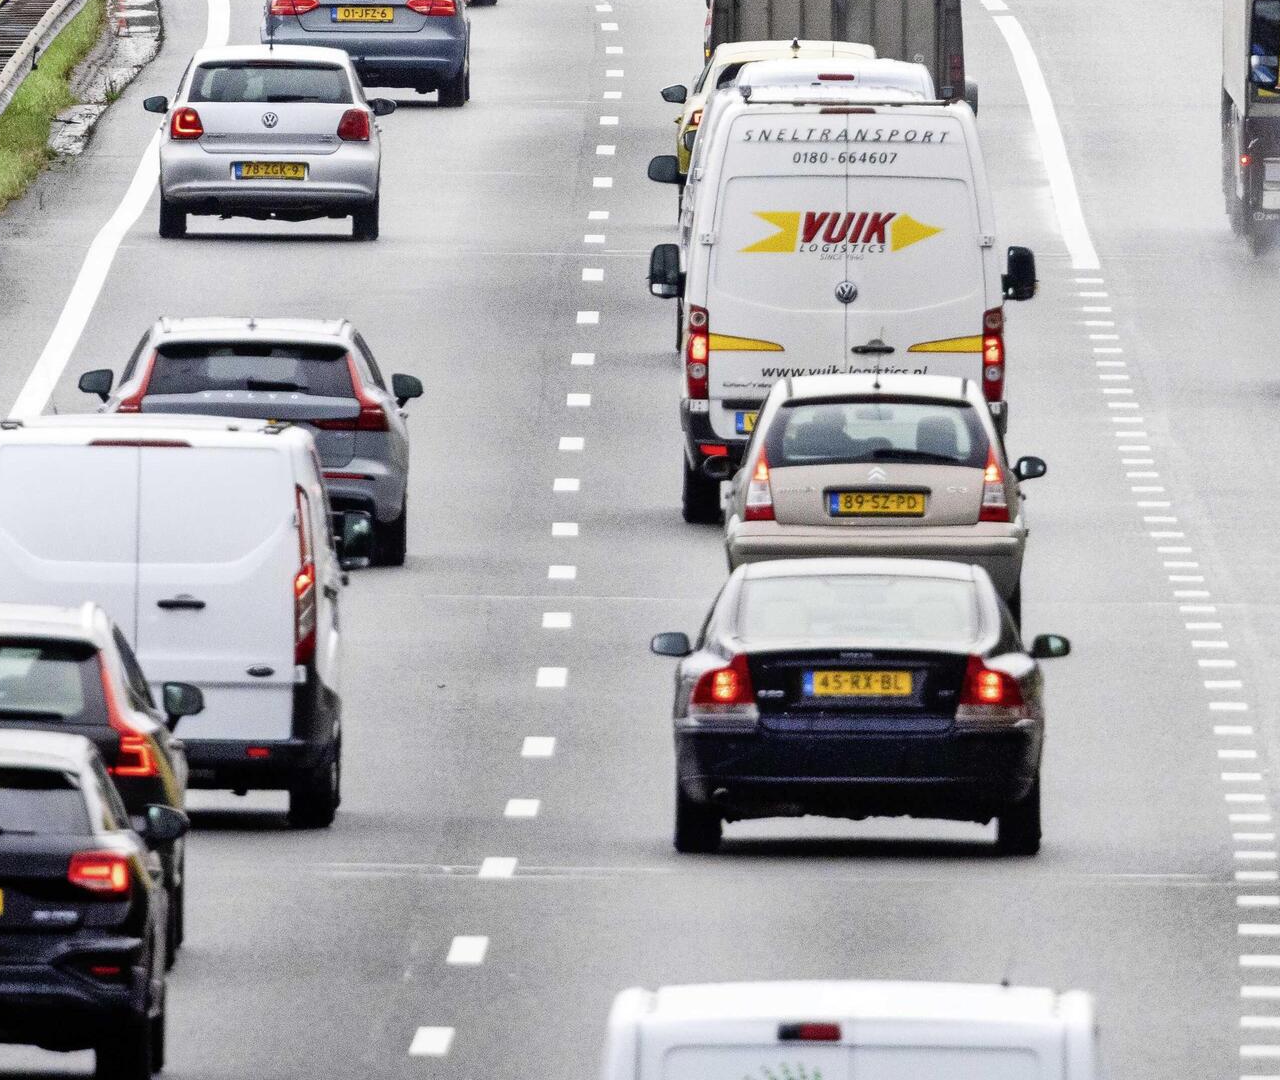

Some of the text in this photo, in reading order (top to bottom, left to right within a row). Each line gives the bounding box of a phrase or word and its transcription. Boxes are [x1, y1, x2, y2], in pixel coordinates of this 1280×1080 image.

[343, 8, 387, 19] 01-JFZ-6
[743, 128, 950, 144] SNELTRANSPORT
[792, 151, 898, 165] 0180-664607
[801, 211, 898, 244] VUIK
[799, 243, 886, 254] LOGISTICS
[203, 392, 299, 400] VOLVO
[843, 494, 918, 509] 89-SZ-PD
